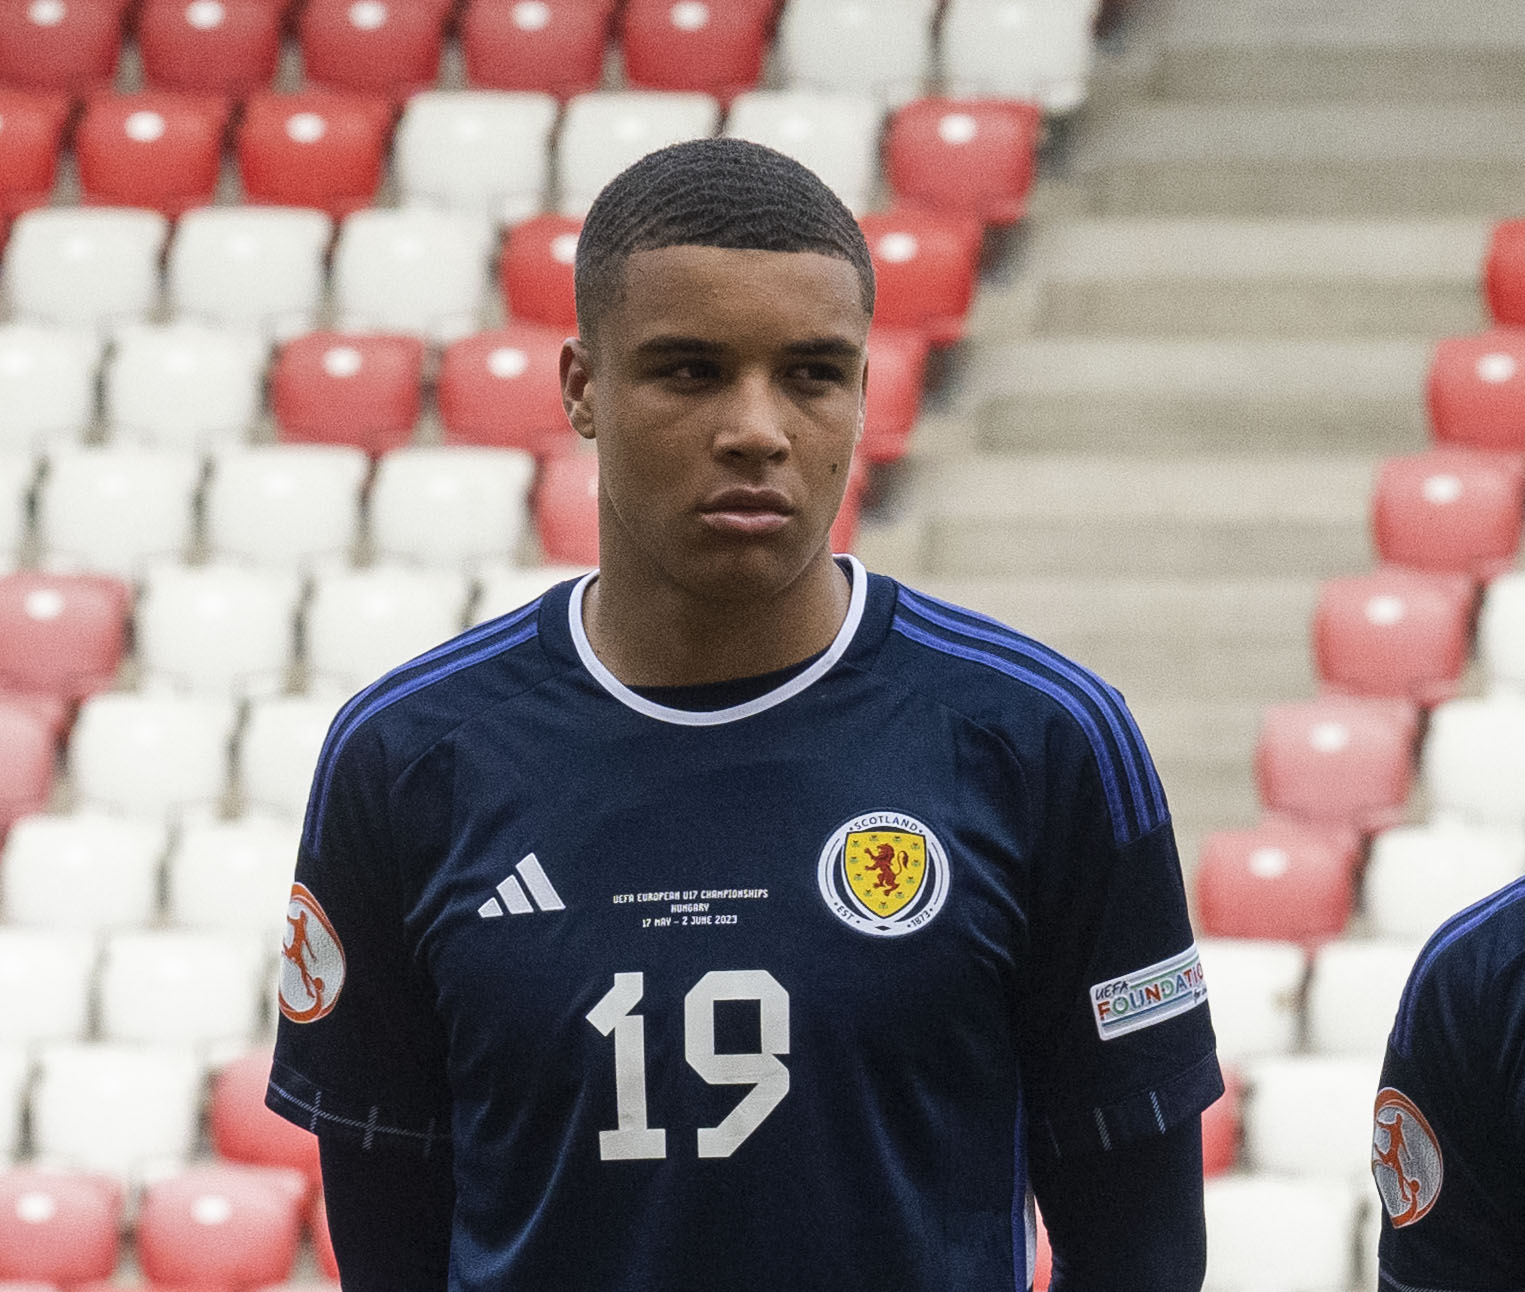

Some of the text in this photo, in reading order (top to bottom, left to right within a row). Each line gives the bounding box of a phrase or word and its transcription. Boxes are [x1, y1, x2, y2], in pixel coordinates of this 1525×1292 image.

[853, 815, 918, 831] SCOTLAND
[612, 889, 769, 904] UEFA EUROPEAN U17 CHAMPIONSHIPS
[670, 903, 710, 913] HUNGARY
[836, 904, 855, 920] EST
[642, 918, 651, 928] 17
[654, 917, 672, 927] MAY
[682, 916, 688, 926] 2
[690, 915, 713, 925] JUNE
[715, 914, 738, 925] 2023
[910, 910, 931, 927] 1873
[1095, 981, 1129, 1000] UEFA
[586, 970, 789, 1160] 19
